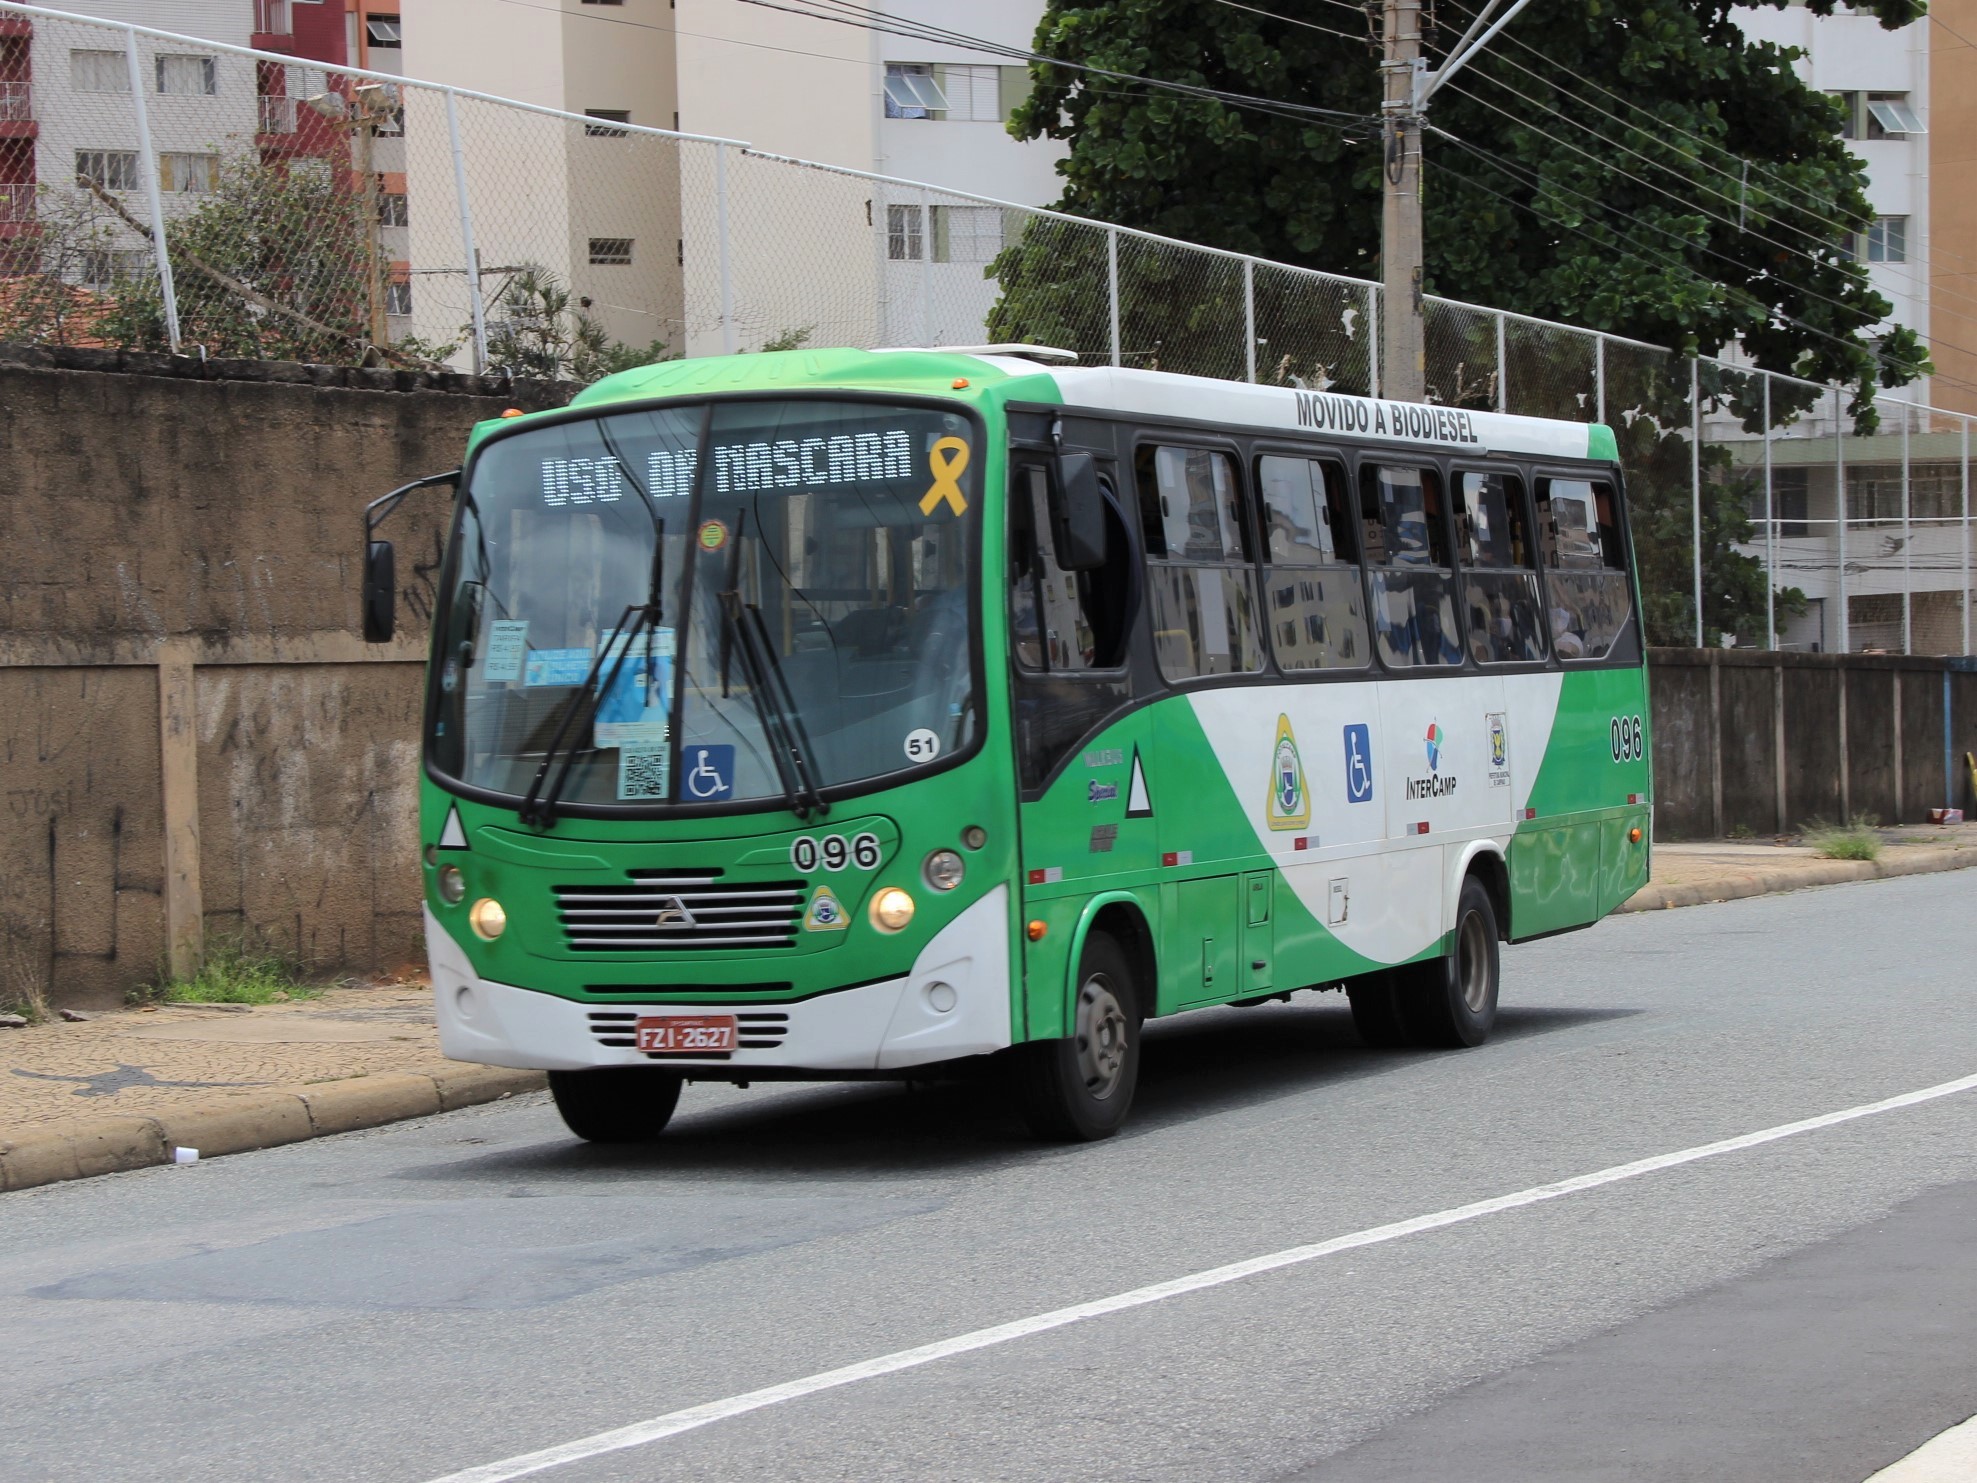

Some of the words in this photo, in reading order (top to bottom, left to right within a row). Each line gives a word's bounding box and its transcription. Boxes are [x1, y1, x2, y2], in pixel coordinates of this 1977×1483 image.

[1295, 392, 1369, 433] MOVIDO
[1375, 402, 1387, 435] A
[1389, 404, 1478, 444] BIODIESEL
[909, 736, 934, 756] 51
[1610, 714, 1643, 764] 096
[789, 832, 882, 873] 096
